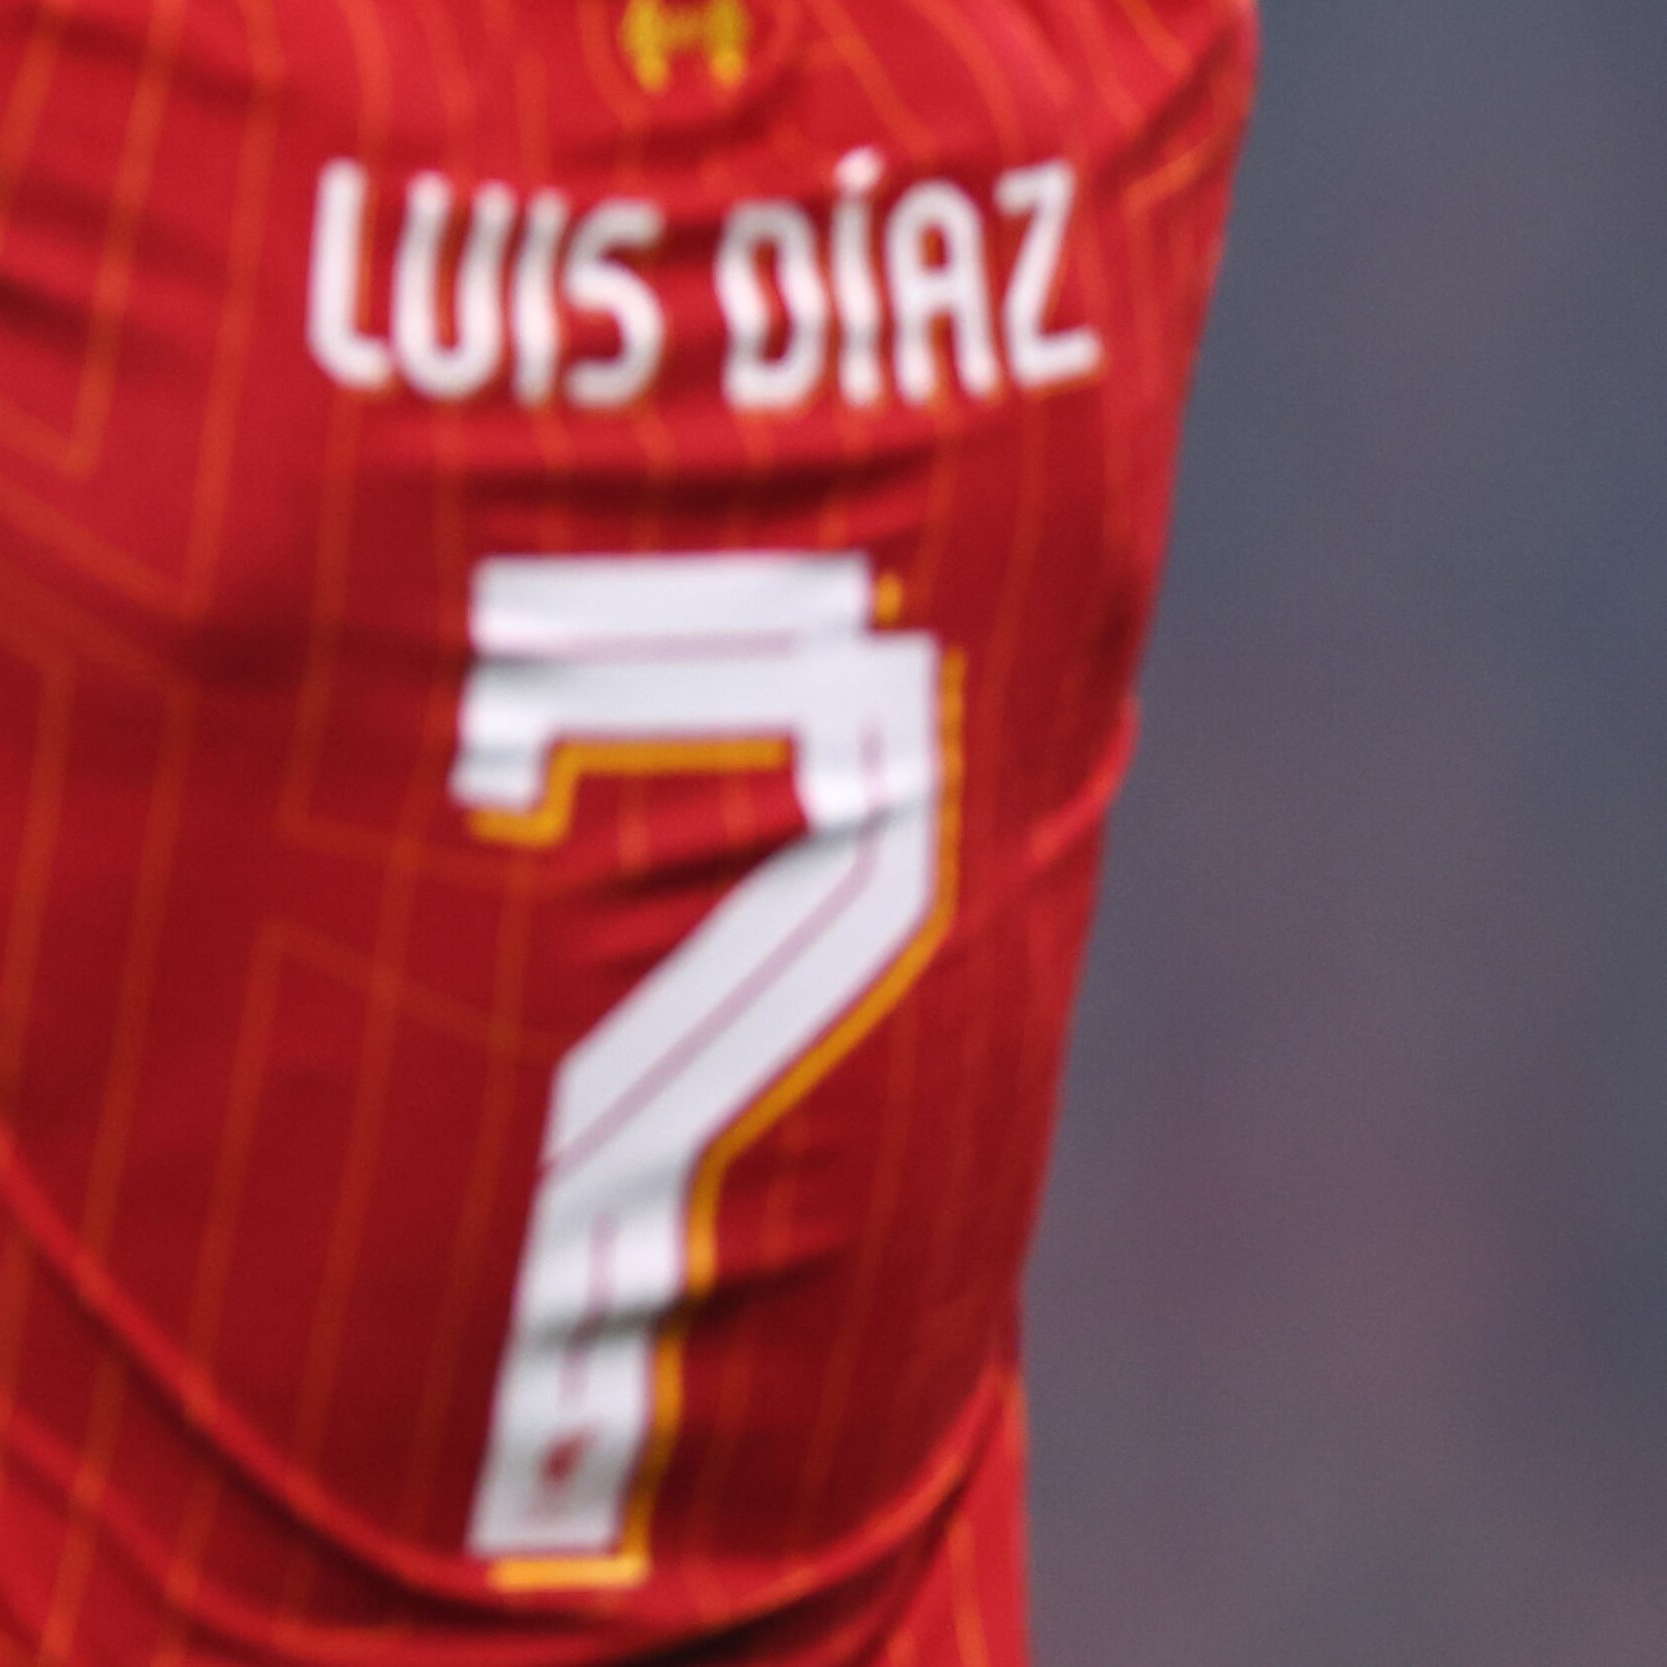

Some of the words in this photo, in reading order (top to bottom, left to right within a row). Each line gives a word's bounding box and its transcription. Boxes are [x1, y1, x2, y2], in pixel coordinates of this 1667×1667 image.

[307, 156, 667, 410] LUIS
[712, 144, 1104, 410] DÍAZ
[450, 548, 965, 1592] 7
